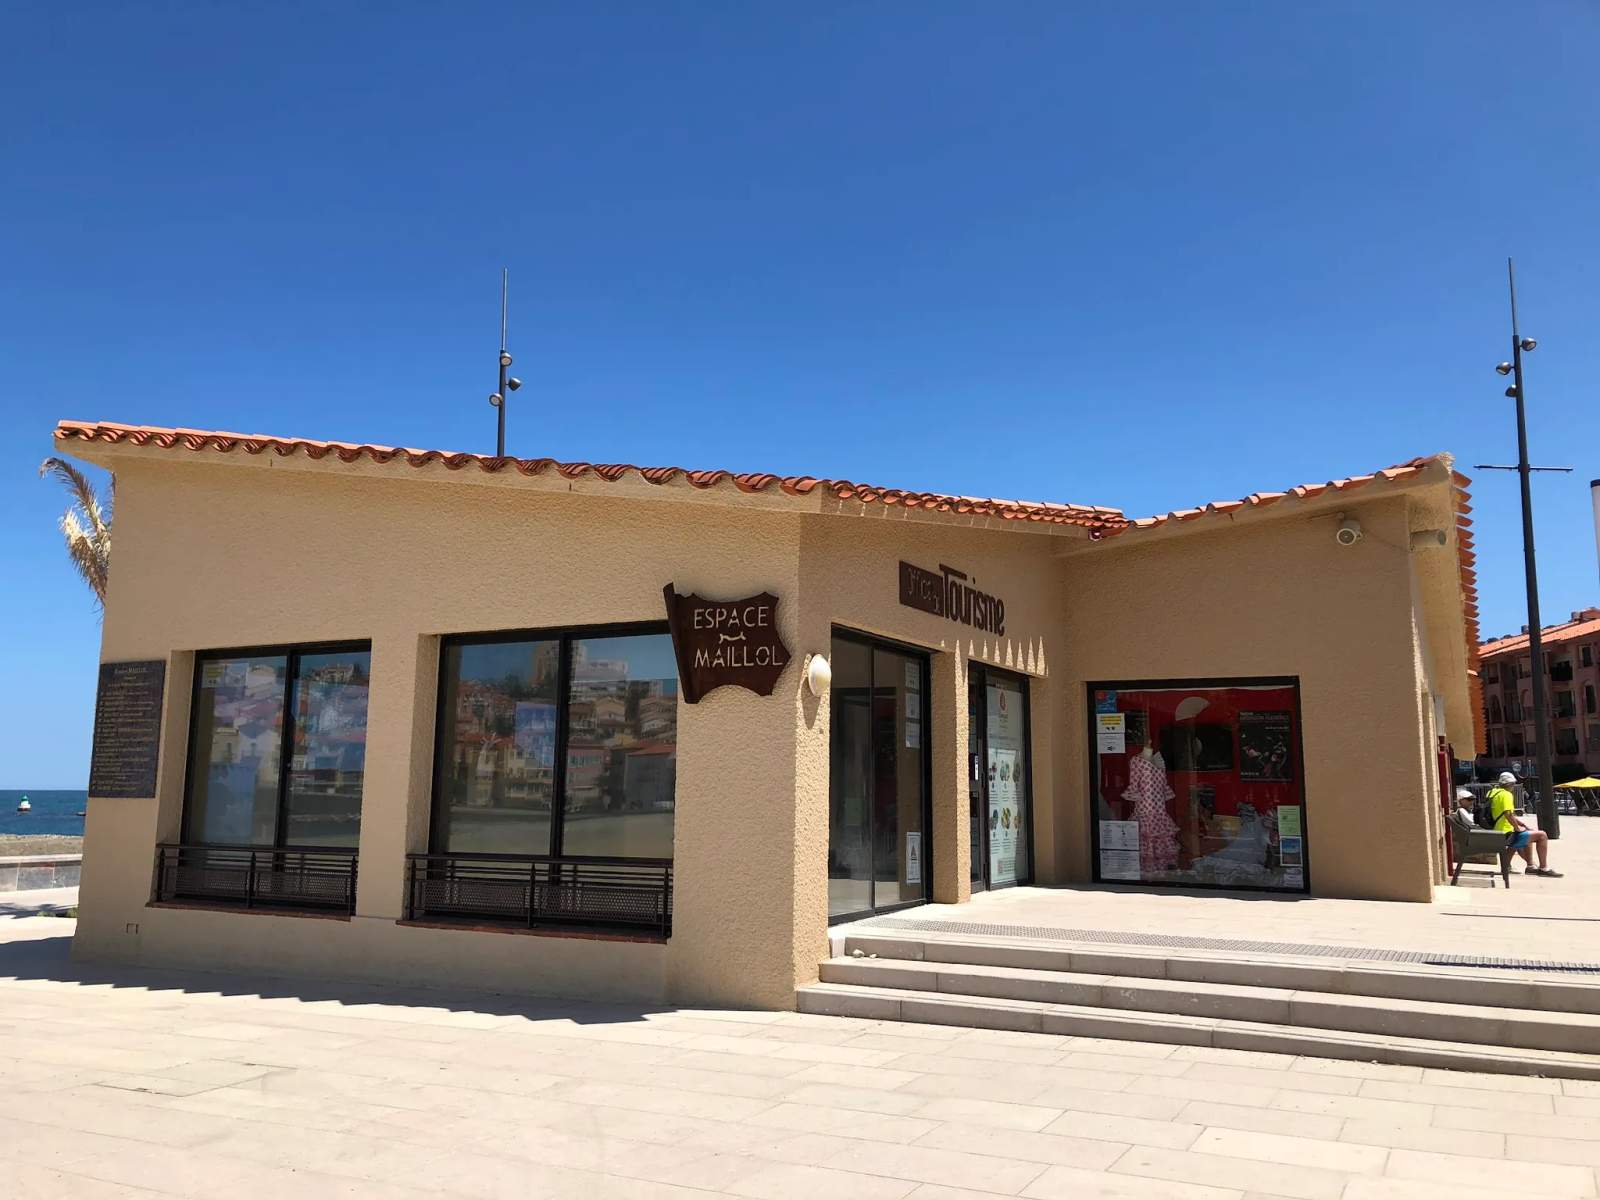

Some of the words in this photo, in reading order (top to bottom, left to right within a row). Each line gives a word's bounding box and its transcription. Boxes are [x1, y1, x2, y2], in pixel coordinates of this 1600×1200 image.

[939, 563, 1005, 637] Tourisme
[694, 606, 769, 629] ESPACE
[694, 646, 783, 668] MAILLOL
